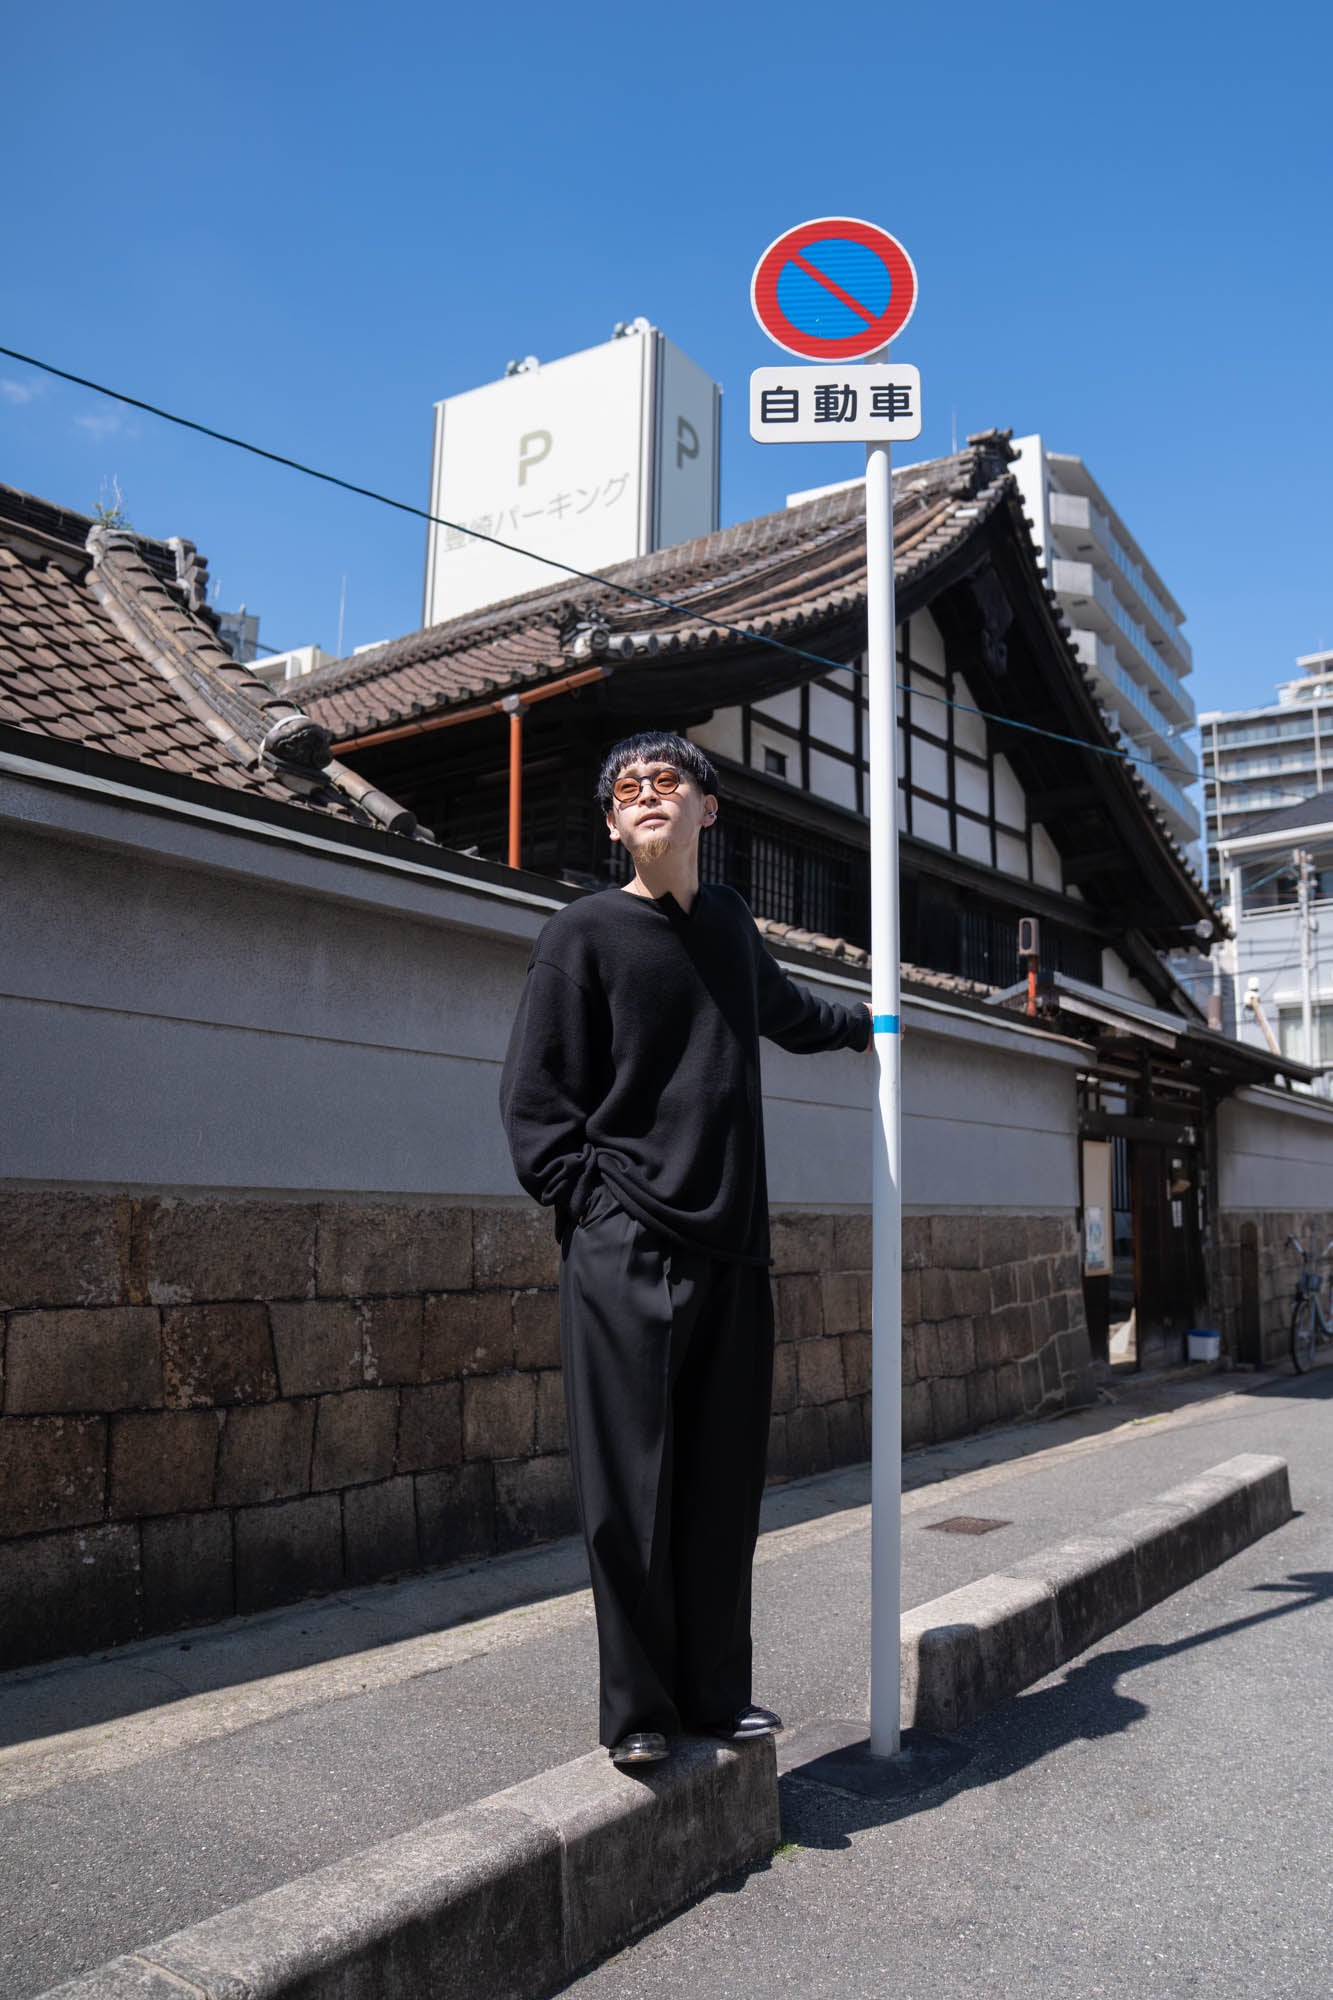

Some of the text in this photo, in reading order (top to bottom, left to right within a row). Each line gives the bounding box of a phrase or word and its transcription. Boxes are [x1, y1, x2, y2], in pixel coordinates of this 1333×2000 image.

[761, 383, 913, 423] 自動車
[518, 429, 553, 487] P
[676, 415, 700, 471] P
